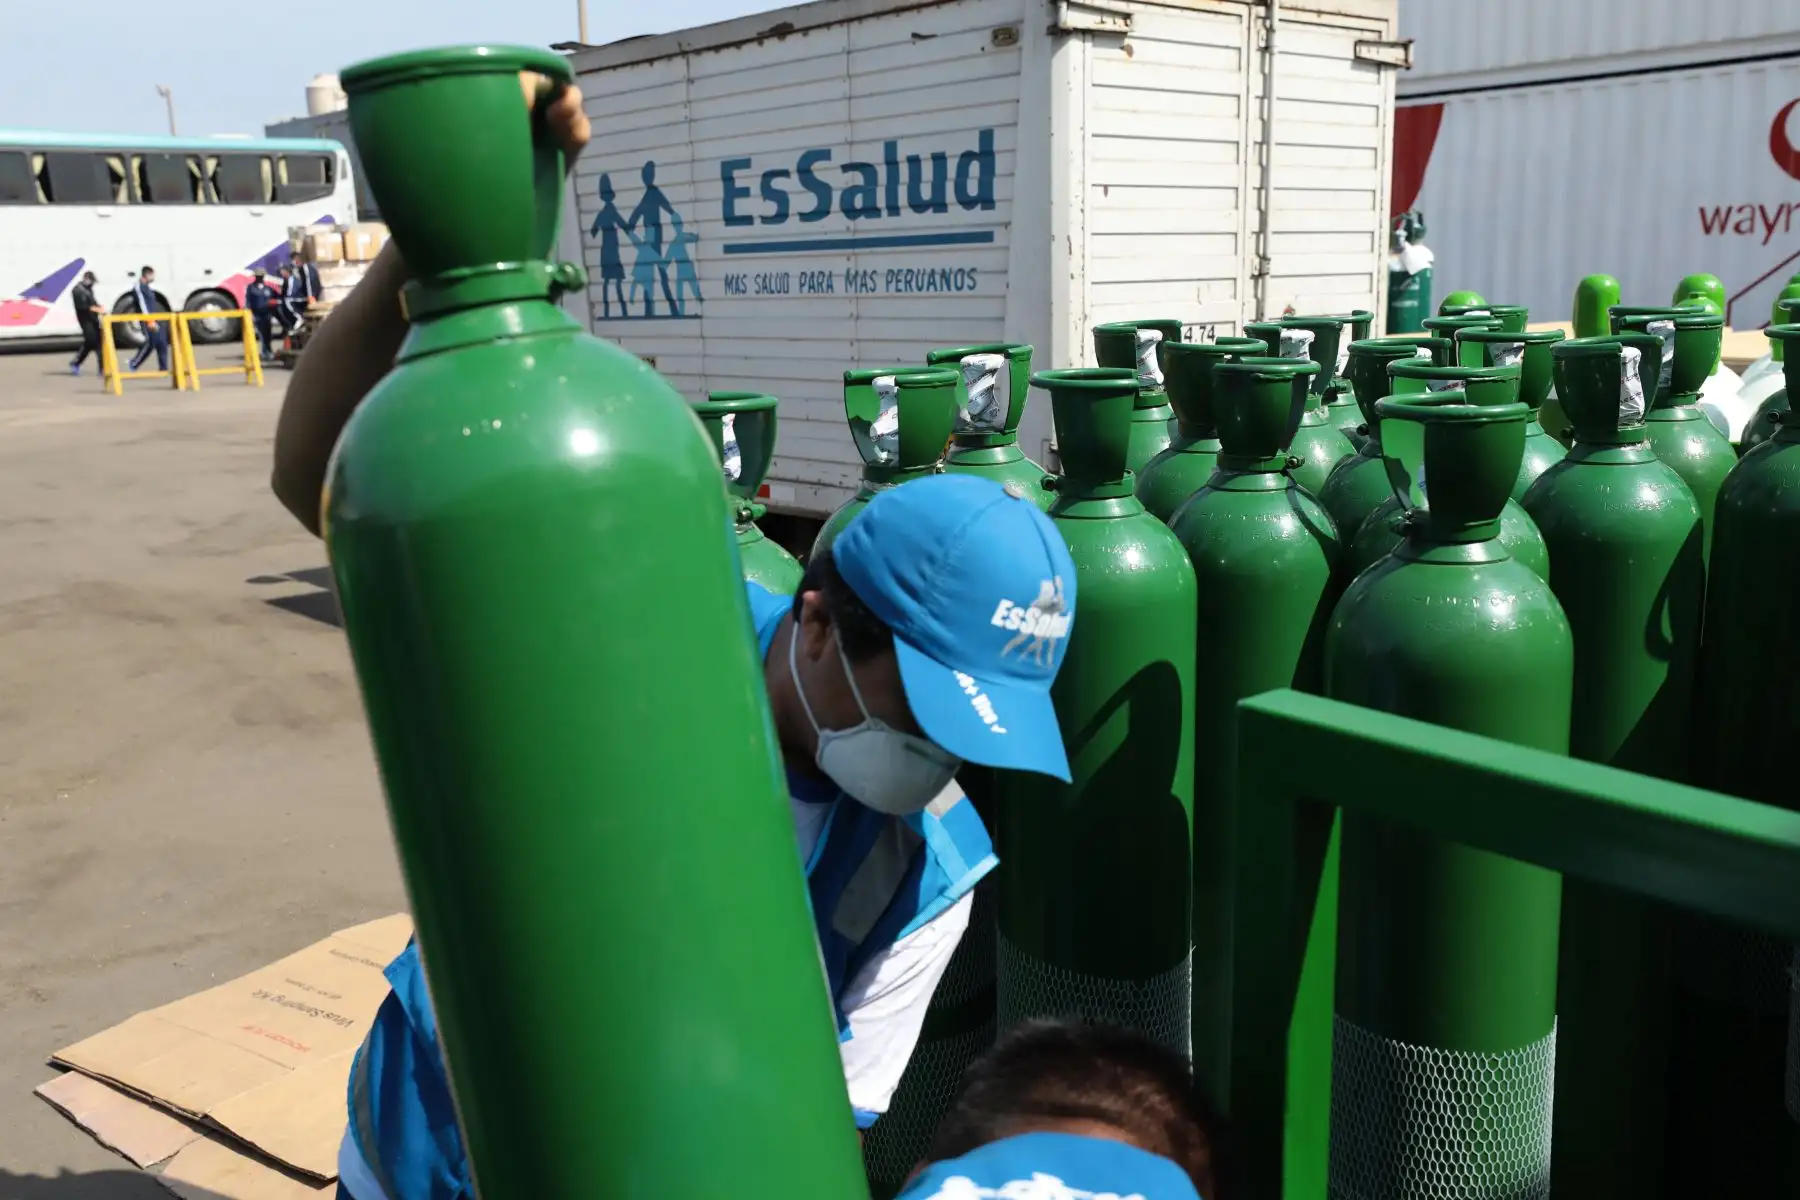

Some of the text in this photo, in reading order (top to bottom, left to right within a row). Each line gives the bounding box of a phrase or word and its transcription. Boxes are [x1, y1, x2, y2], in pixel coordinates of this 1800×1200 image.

[720, 128, 996, 227] EsSalud
[724, 267, 977, 295] MAS SALUD PARA MAS PERUANOS
